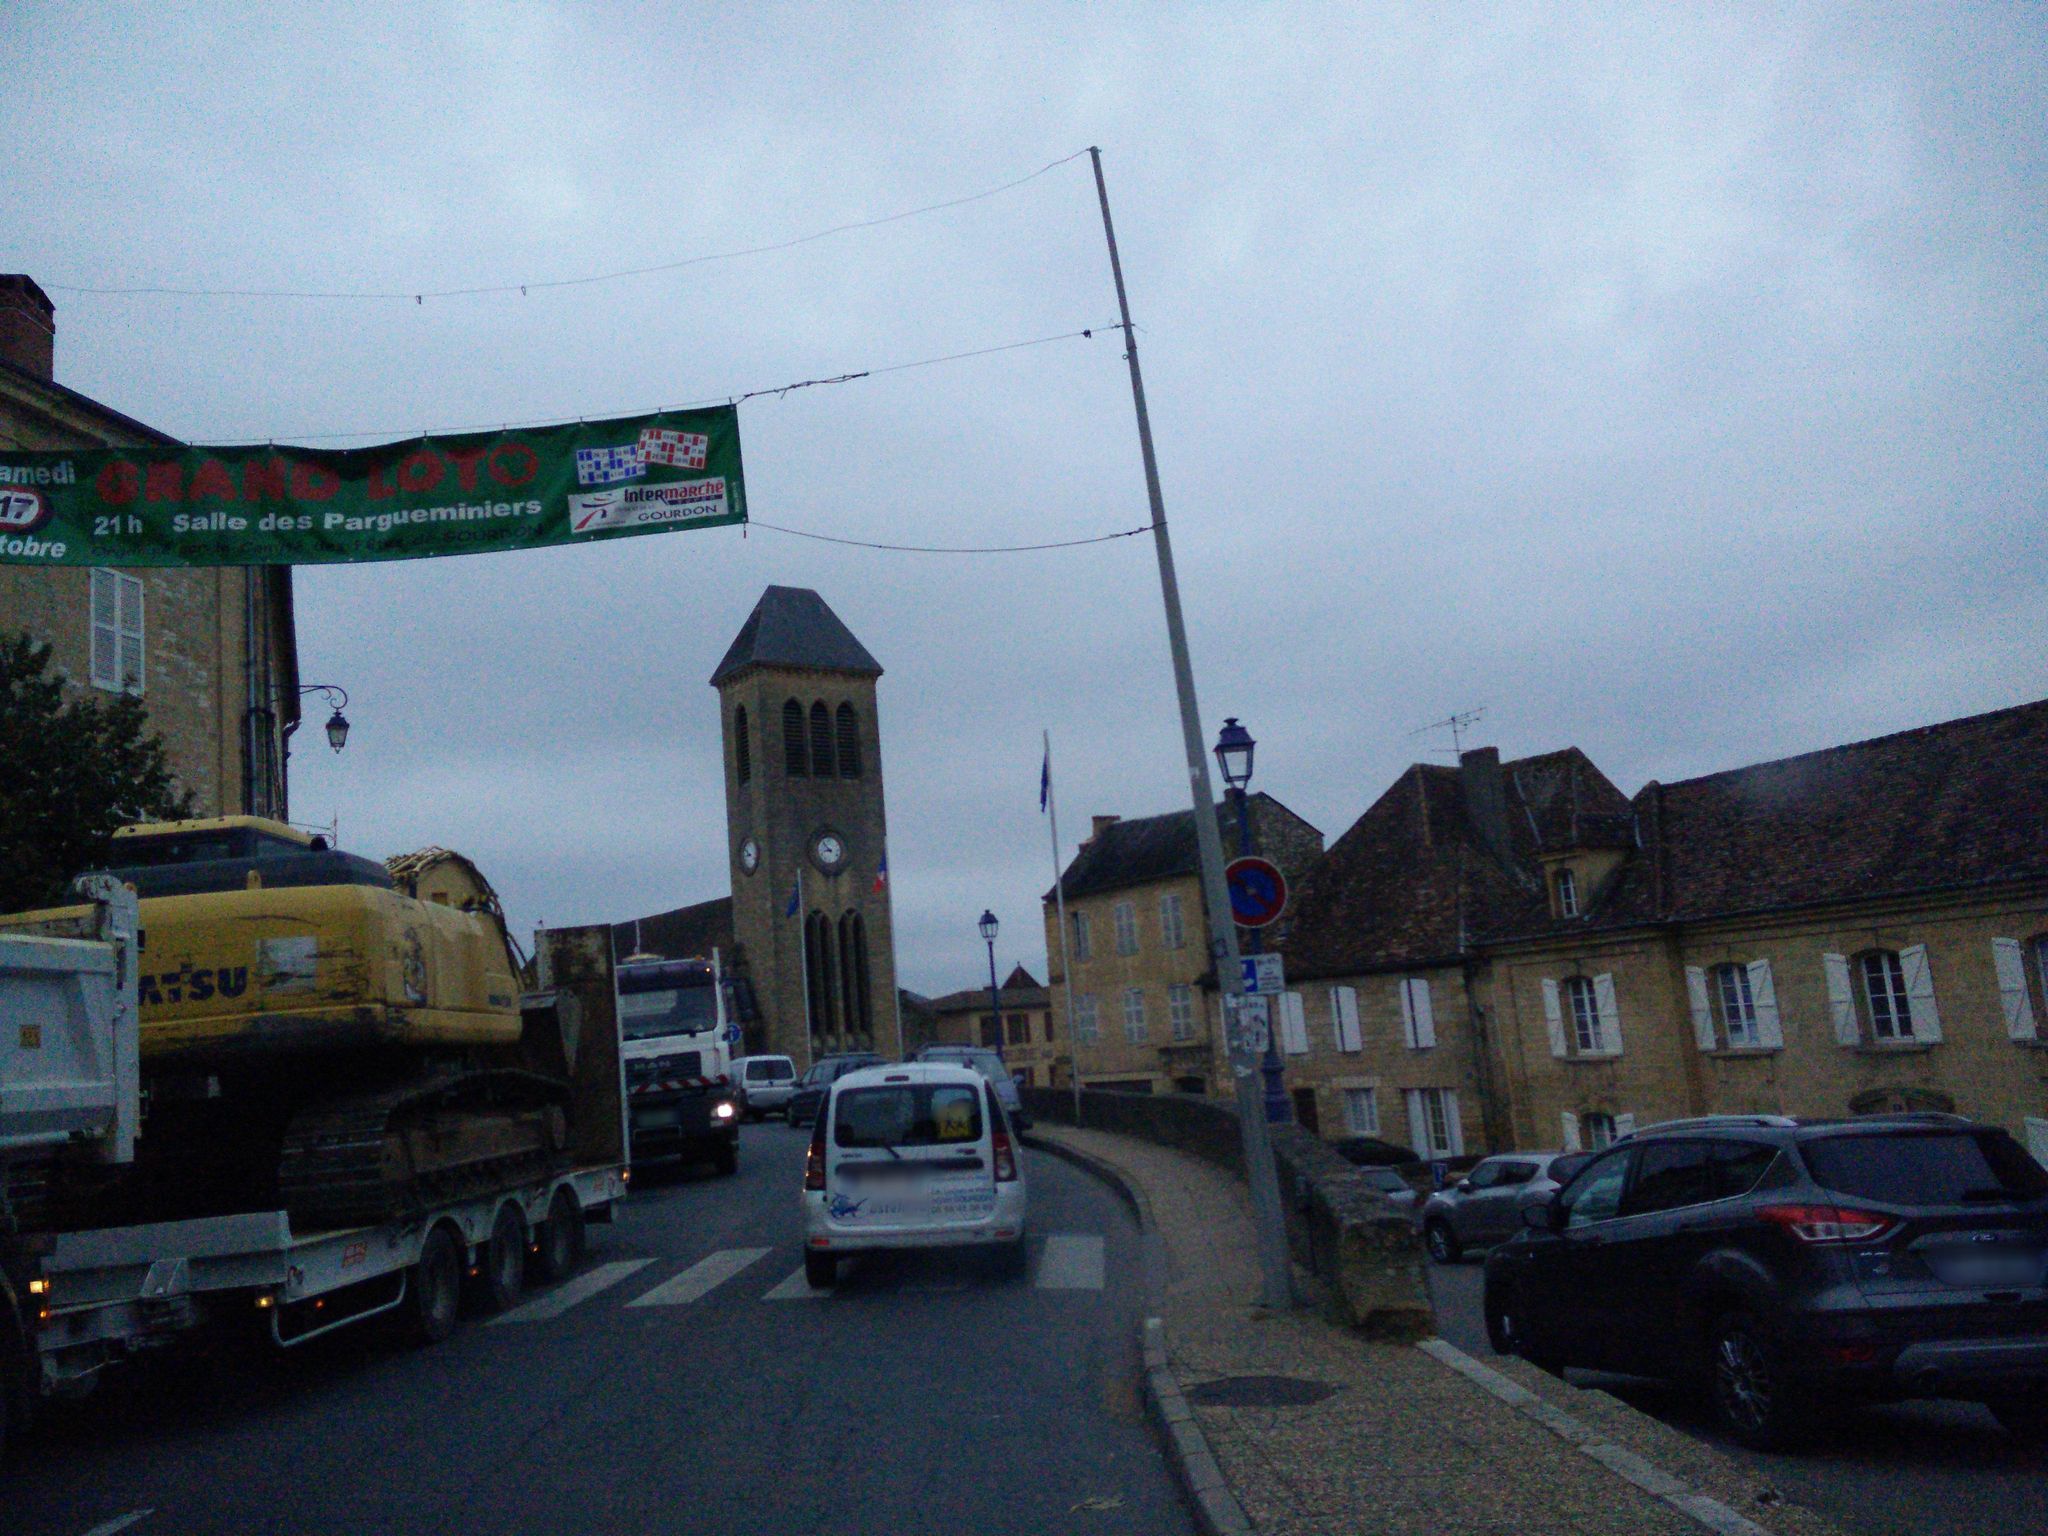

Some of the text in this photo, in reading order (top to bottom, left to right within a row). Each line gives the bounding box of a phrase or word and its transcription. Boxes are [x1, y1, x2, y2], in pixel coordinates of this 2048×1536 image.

[96, 457, 341, 504] GRAND
[367, 443, 539, 499] LOTO
[173, 511, 248, 533] Salle
[258, 512, 312, 531] des
[323, 501, 542, 531] Pargueminiers
[638, 504, 718, 522] GOURDON
